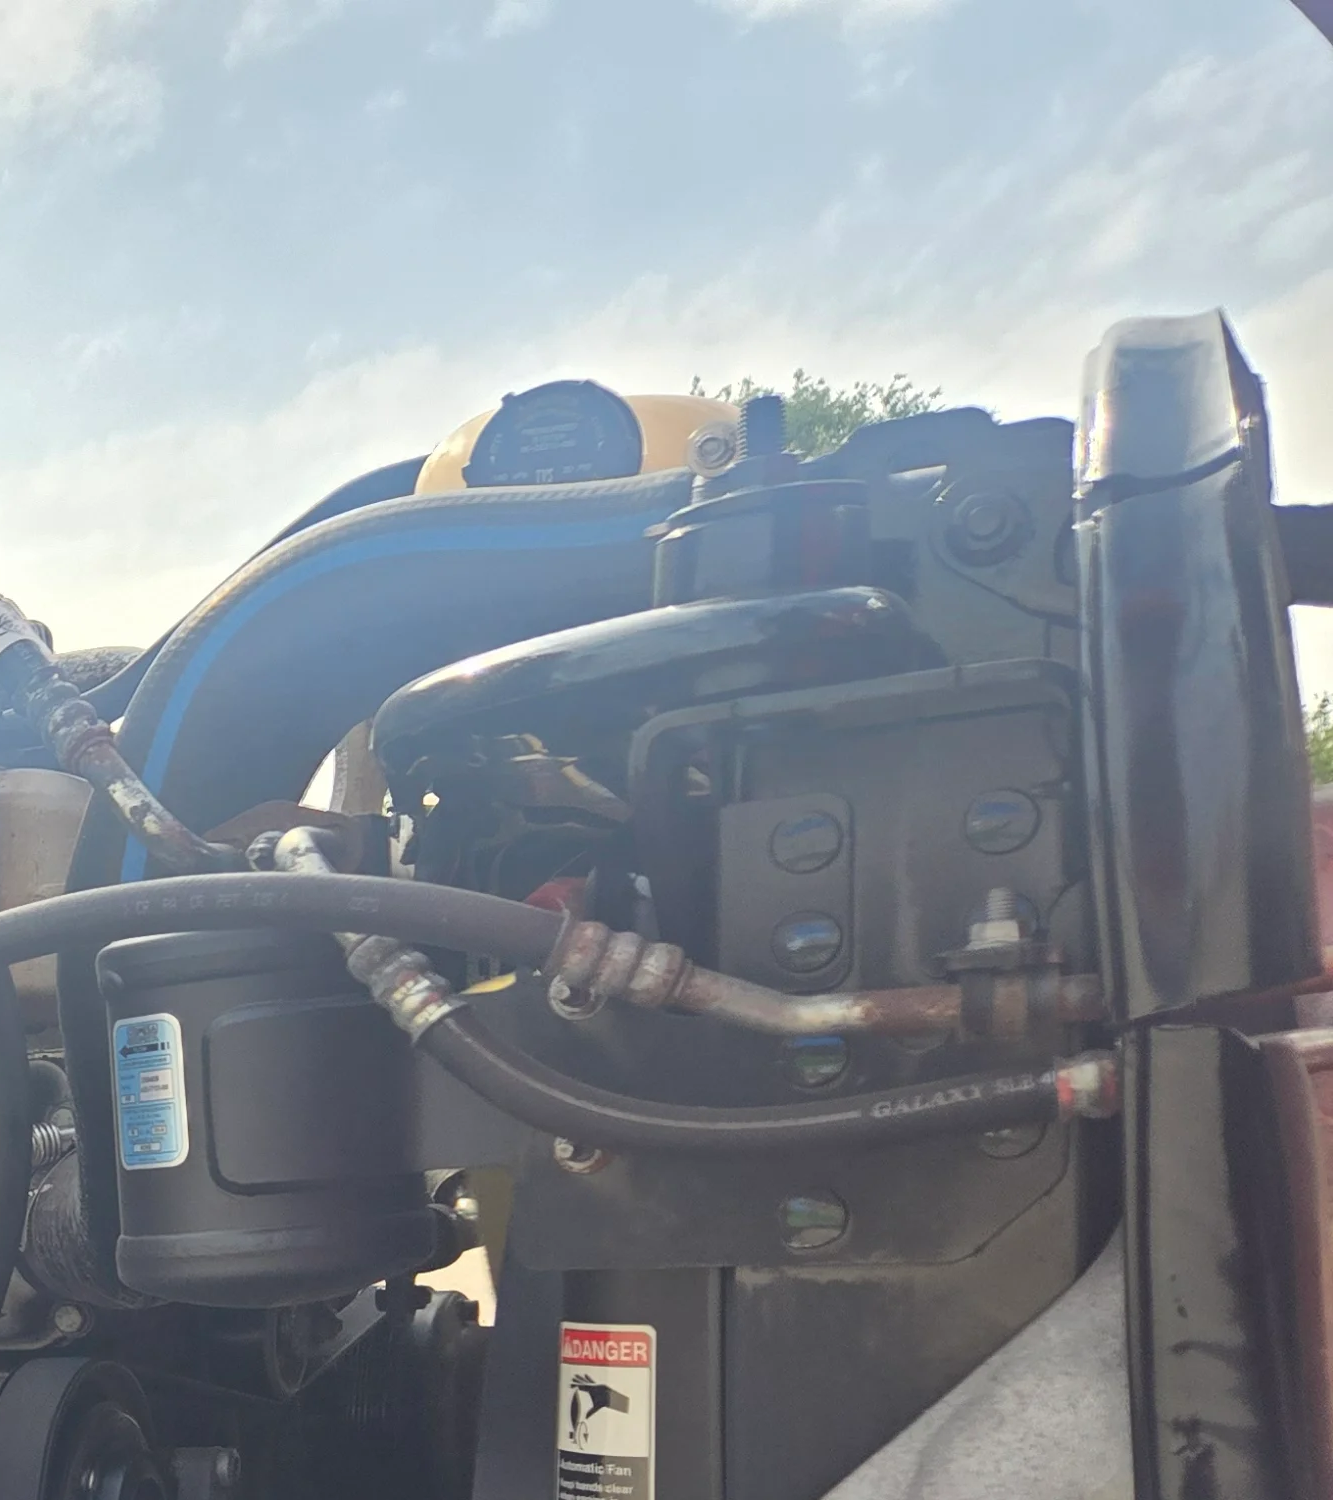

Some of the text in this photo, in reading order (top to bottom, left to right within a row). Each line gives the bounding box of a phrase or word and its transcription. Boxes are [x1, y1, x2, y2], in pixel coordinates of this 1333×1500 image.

[572, 1339, 648, 1362] DANGER
[606, 1463, 632, 1477] Fan
[604, 1483, 634, 1495] clear
